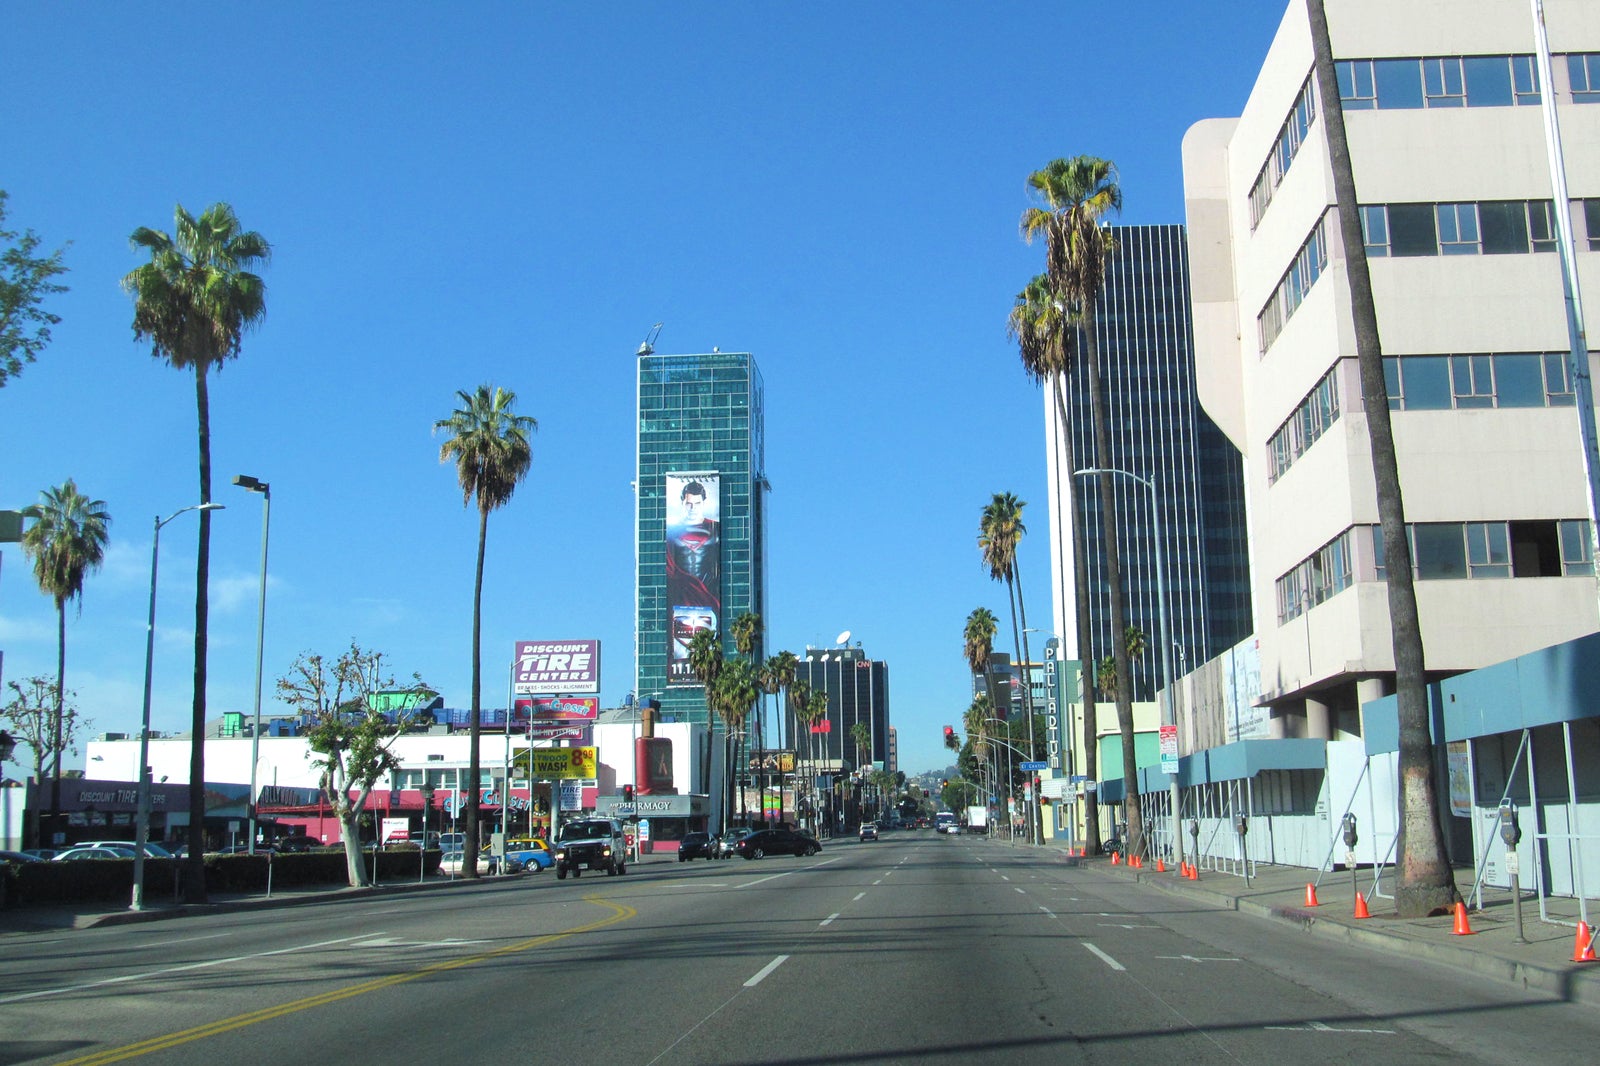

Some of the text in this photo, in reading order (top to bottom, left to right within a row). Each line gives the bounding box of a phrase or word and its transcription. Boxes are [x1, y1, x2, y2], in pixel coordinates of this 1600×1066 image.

[523, 644, 589, 653] DISCOUNT
[520, 671, 590, 680] CENTERS
[550, 700, 590, 716] CLOSET
[1046, 648, 1059, 768] PALLADIUM
[538, 762, 568, 772] WASH
[80, 791, 115, 803] DISCOUNT
[117, 790, 136, 804] TIRE
[482, 790, 530, 812] CLSET
